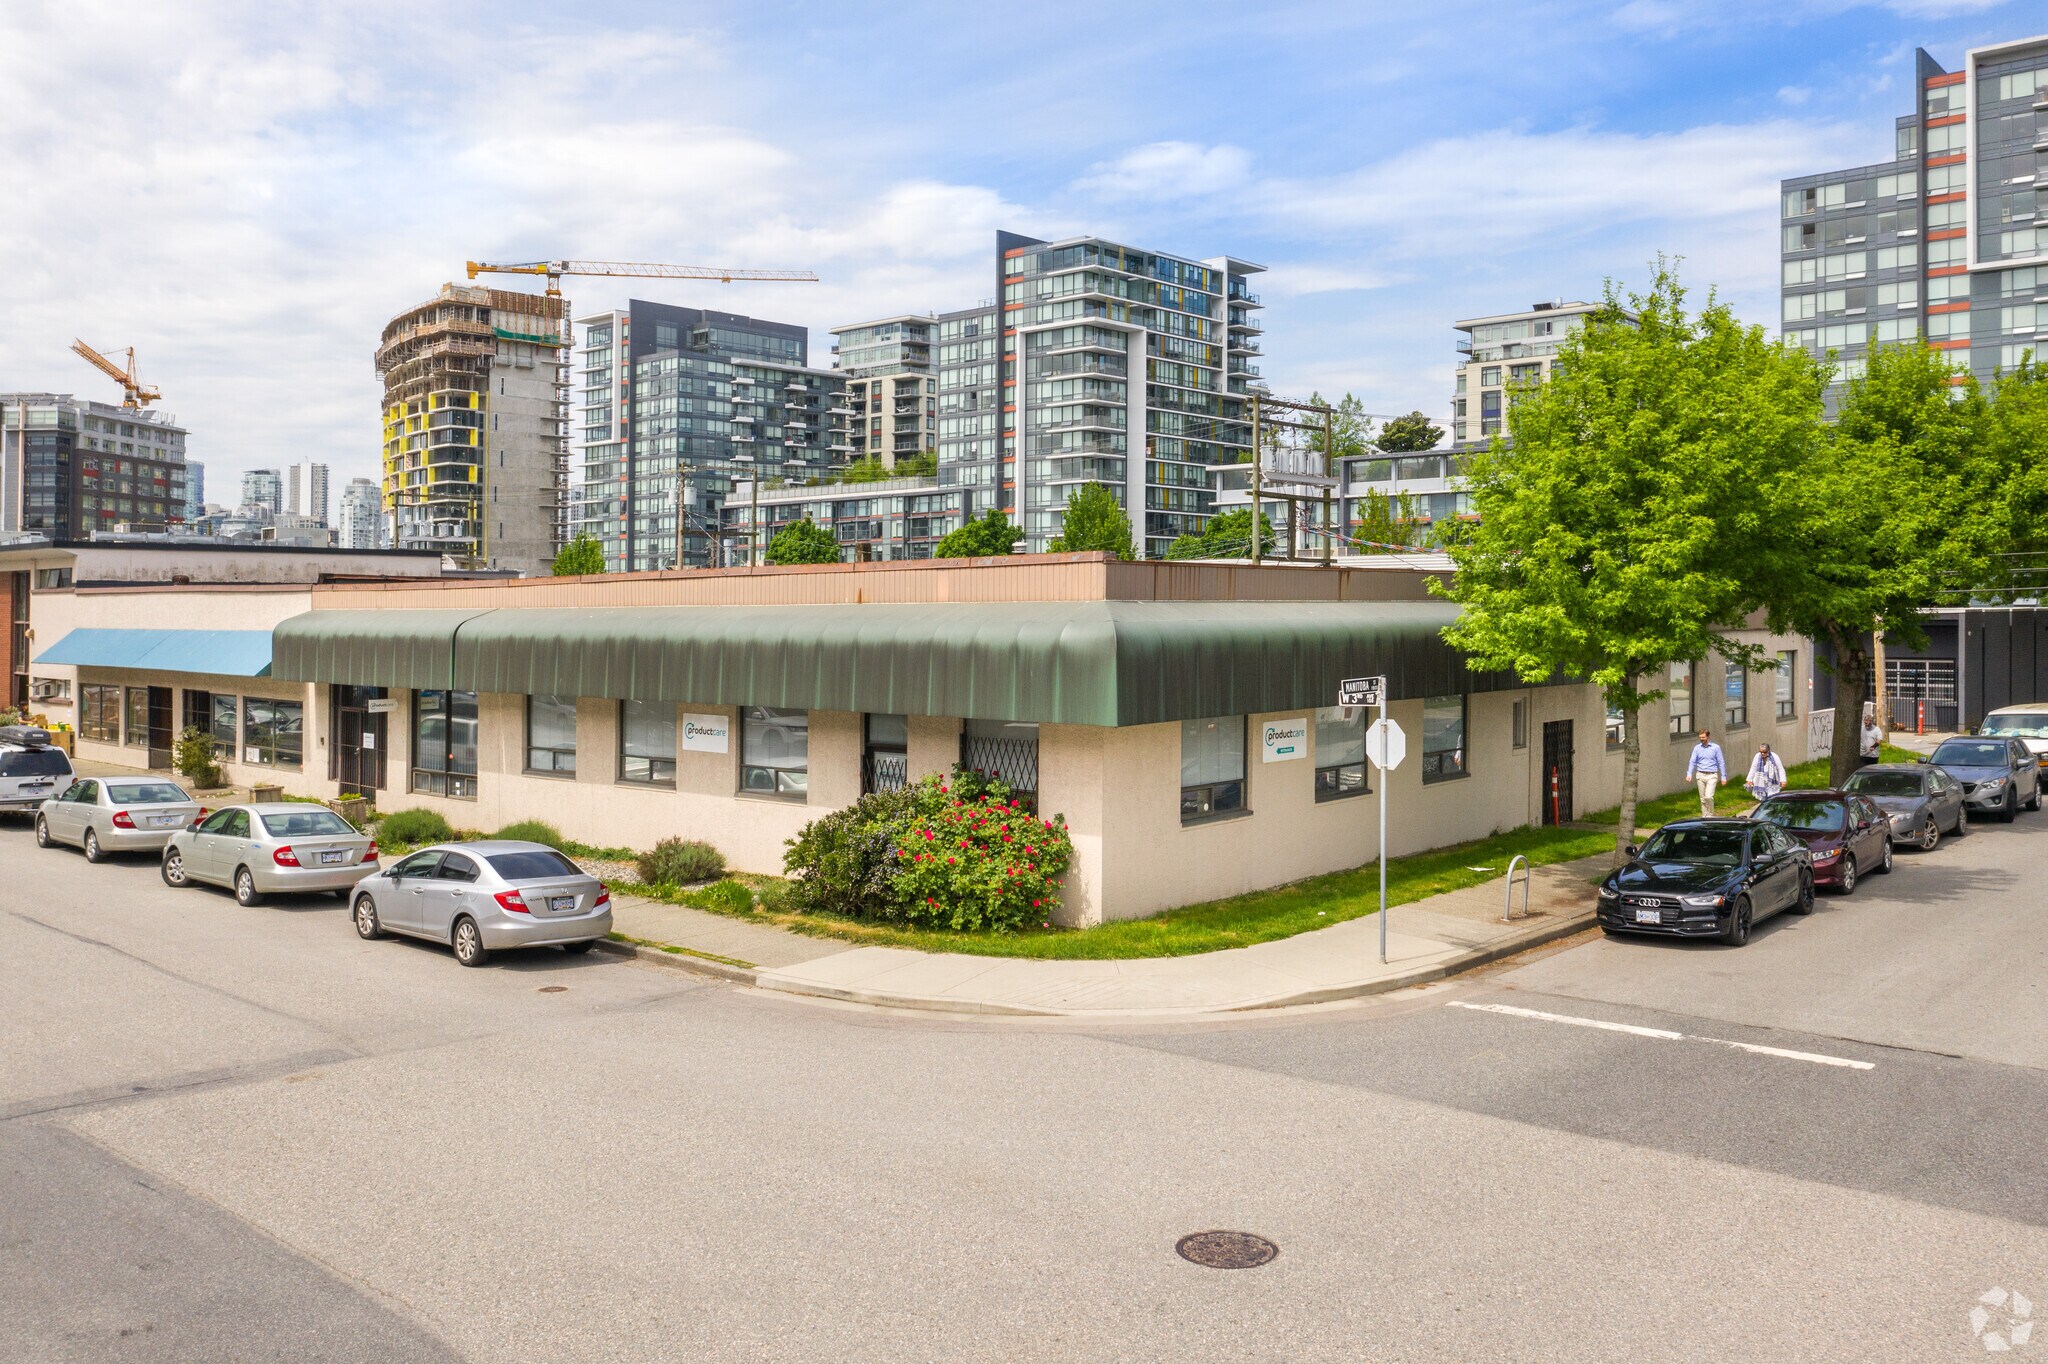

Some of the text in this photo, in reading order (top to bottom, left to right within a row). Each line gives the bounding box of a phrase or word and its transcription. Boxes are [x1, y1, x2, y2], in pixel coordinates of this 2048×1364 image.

[1345, 681, 1370, 692] MANITOBA
[1342, 694, 1350, 703] W
[687, 726, 727, 737] productcare
[1268, 729, 1305, 741] productcare
